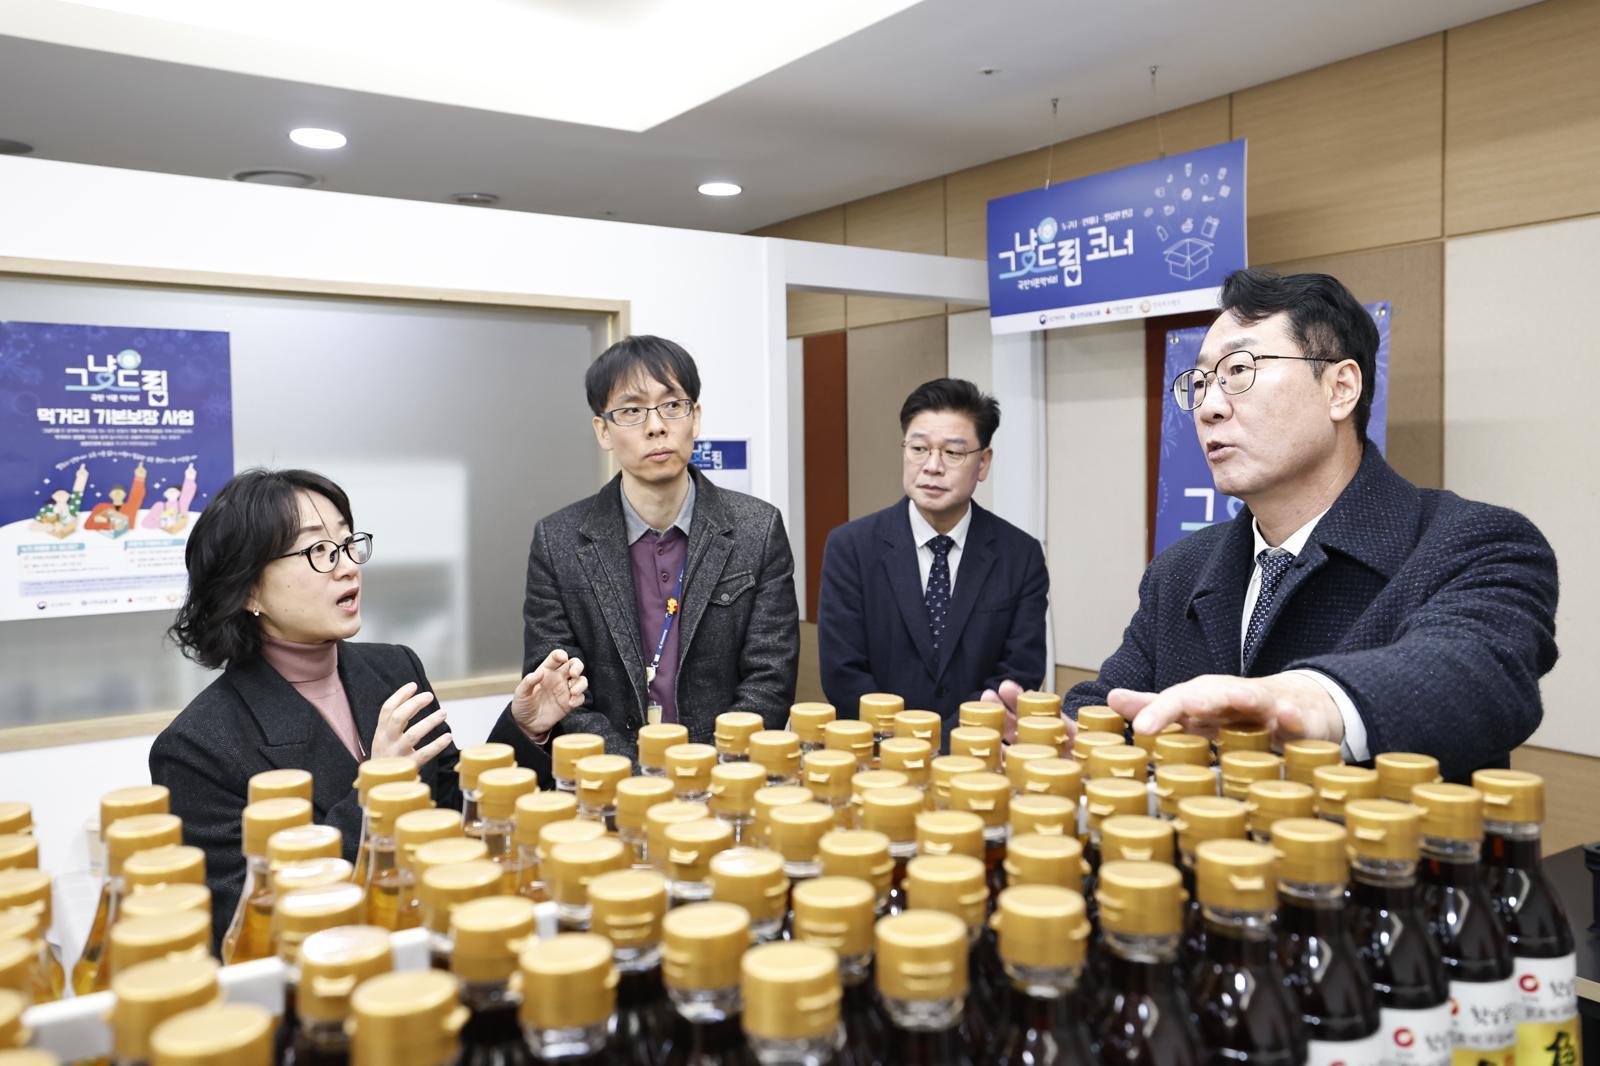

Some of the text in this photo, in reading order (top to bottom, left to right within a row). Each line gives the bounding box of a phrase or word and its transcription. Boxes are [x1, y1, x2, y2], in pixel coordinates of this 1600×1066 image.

[998, 217, 1134, 288] 그냥드림 코너
[65, 349, 169, 407] 그냥드림
[37, 408, 195, 426] 먹거리 기본보장 사업
